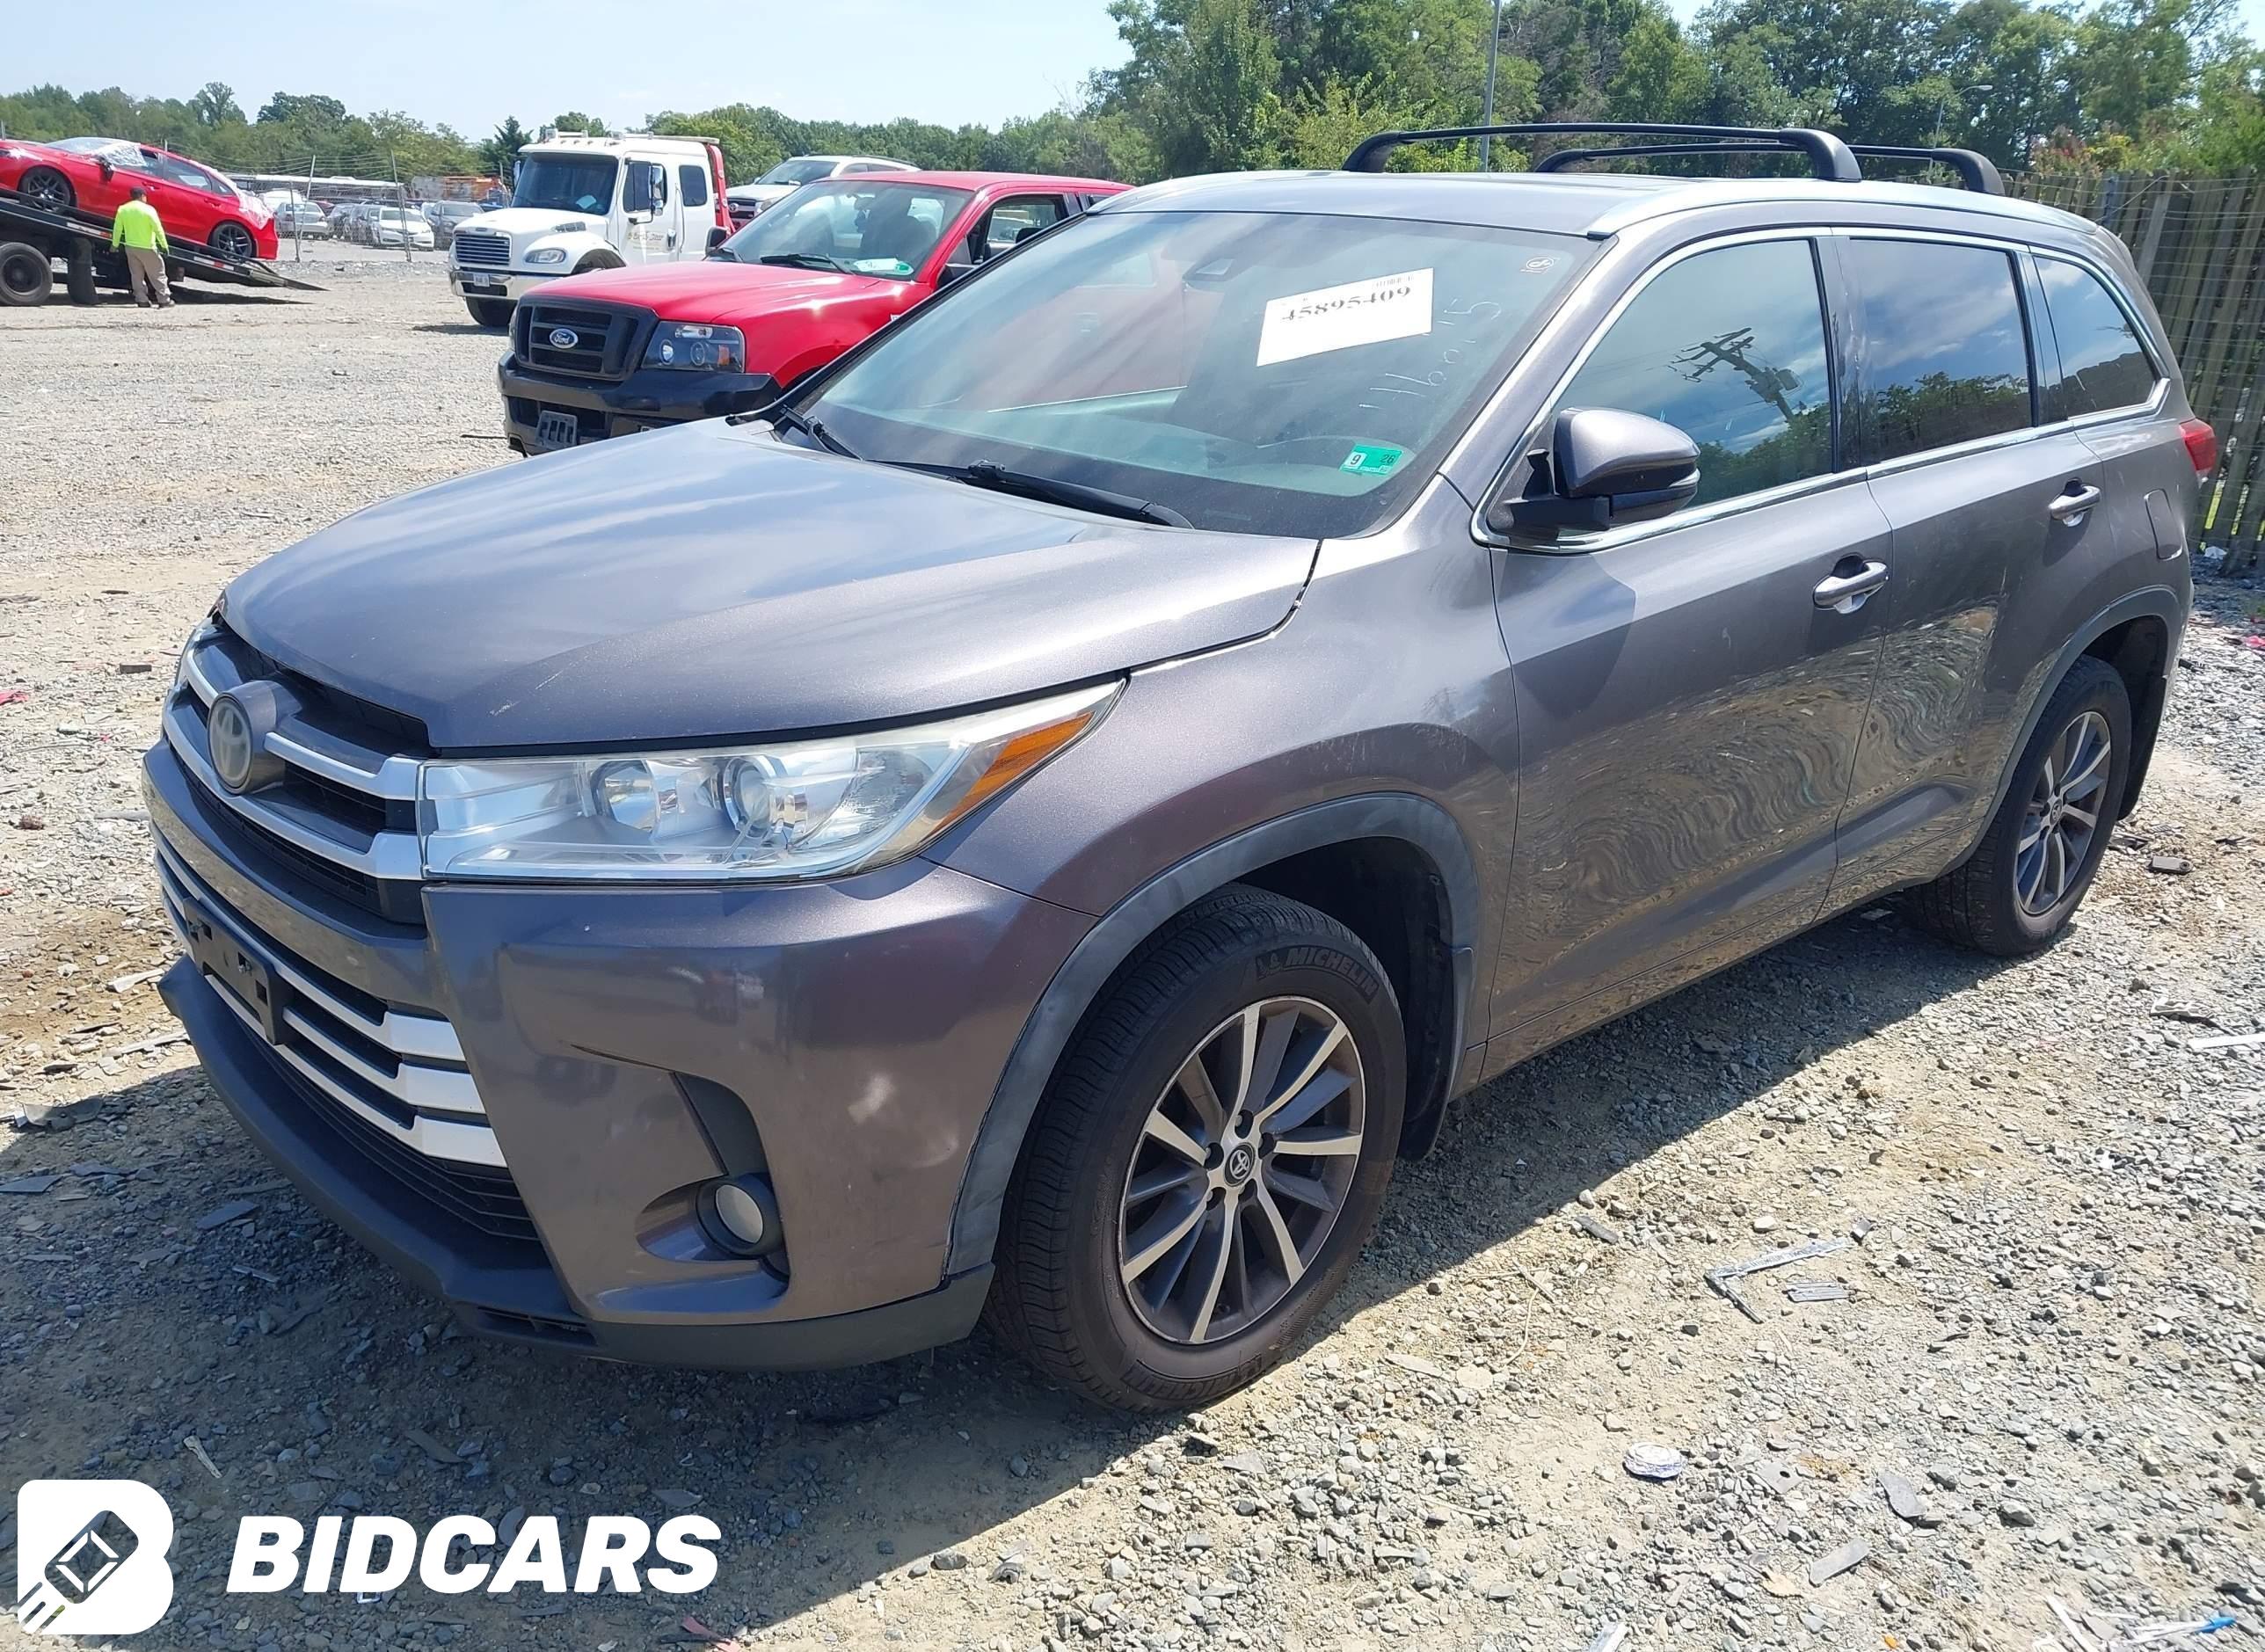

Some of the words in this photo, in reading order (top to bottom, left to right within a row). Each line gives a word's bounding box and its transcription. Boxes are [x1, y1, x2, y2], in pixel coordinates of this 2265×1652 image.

[1280, 286, 1411, 323] 45895409
[1350, 454, 1362, 466] 9
[1380, 454, 1396, 464] 26
[1285, 947, 1377, 998] MICHELIN
